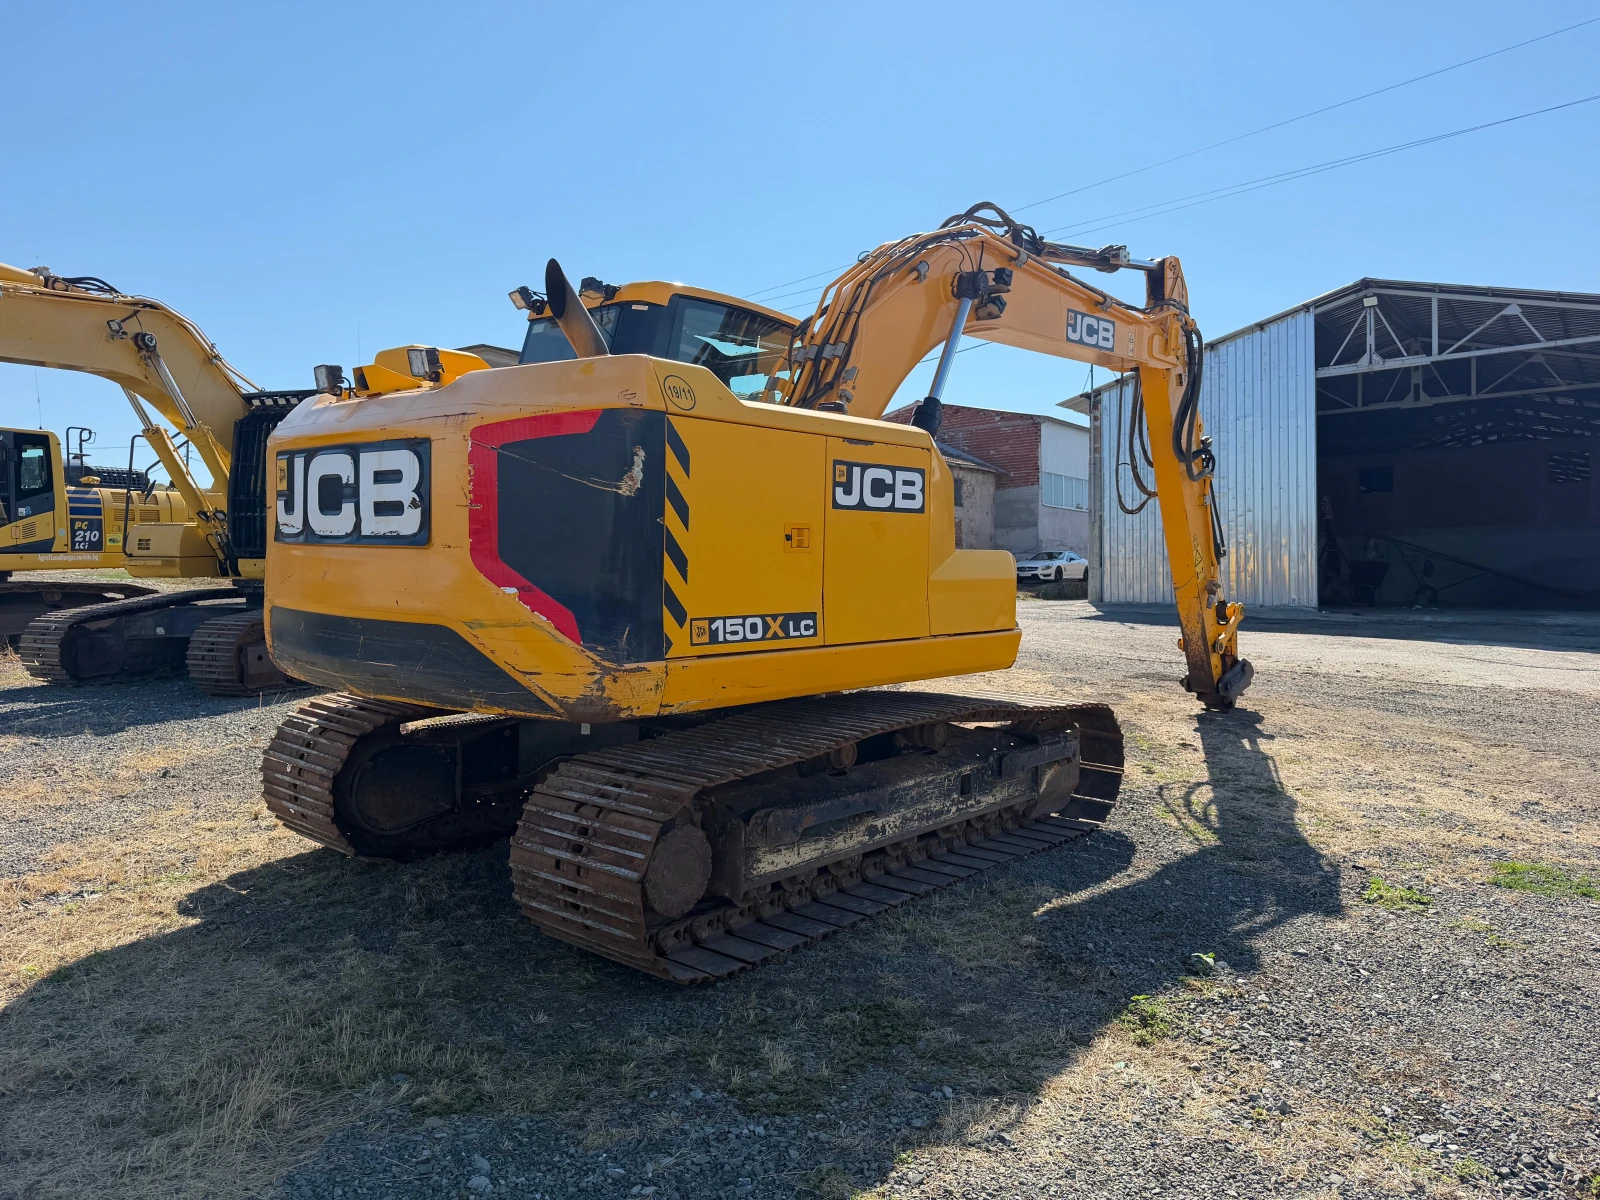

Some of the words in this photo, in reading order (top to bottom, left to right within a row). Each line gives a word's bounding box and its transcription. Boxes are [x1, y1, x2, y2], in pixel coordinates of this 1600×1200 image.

[1067, 314, 1114, 349] JCB
[668, 384, 693, 401] 19/11
[276, 450, 422, 536] JCB
[835, 466, 924, 509] JCB
[74, 521, 88, 530] PC
[74, 530, 100, 542] 210
[789, 619, 815, 637] LC
